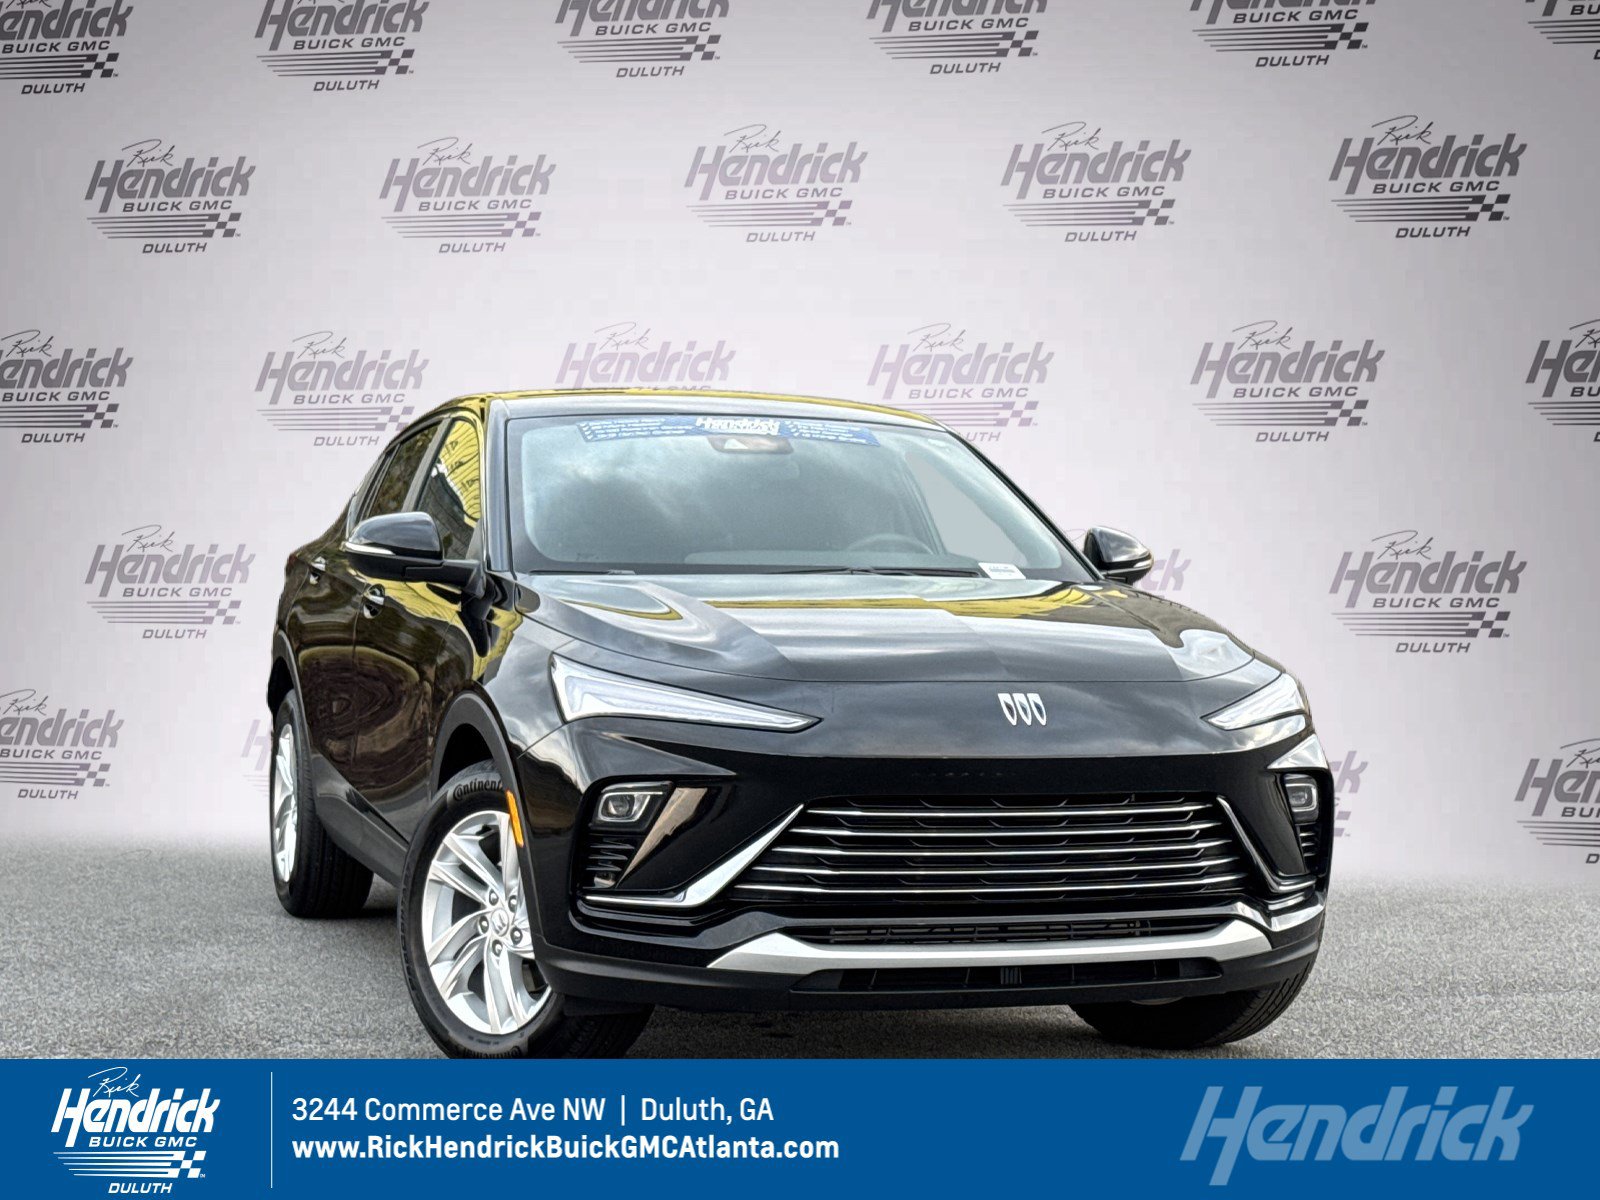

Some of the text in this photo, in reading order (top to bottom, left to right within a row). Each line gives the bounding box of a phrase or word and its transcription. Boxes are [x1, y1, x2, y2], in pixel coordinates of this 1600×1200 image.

[0, 0, 133, 40] endrick
[1233, 11, 1301, 23] BUICK
[1309, 9, 1358, 20] GMC
[255, 0, 429, 51] Hendrick
[595, 22, 711, 35] BUICK GMC
[909, 18, 1028, 31] BUICK GMC
[2, 41, 110, 54] BUICK GMC
[293, 37, 405, 50] BUICK GMC
[1256, 55, 1329, 67] DULUTH
[616, 66, 684, 77] DULUTH
[930, 63, 1001, 74] DULUTH
[21, 83, 85, 94] DULUTH
[314, 80, 379, 91] DULUTH
[1001, 139, 1191, 199] Hendrick
[1328, 133, 1527, 195] Hendrick
[684, 141, 868, 200] Hendrick
[84, 156, 256, 213] Hendrick
[379, 153, 556, 212] Hendrick
[1373, 181, 1499, 194] BUICK GMC
[725, 188, 842, 199] BUICK GMC
[1043, 186, 1165, 198] BUICK GMC
[123, 200, 232, 212] BUICK GMC
[419, 199, 531, 211] BUICK GMC
[746, 232, 815, 242] DULUTH
[1065, 231, 1137, 242] DULUTH
[1396, 226, 1471, 238] DULUTH
[142, 243, 207, 253] DULUTH
[439, 242, 505, 253] DULUTH
[0, 347, 133, 389] endrick
[555, 340, 737, 389] Hendrick
[1190, 339, 1385, 398] Hendrick
[254, 349, 430, 405] Hendrick
[867, 342, 1055, 400] Hendrick
[2, 391, 110, 402] BUICK GMC
[909, 388, 1028, 399] BUICK GMC
[1234, 386, 1358, 398] BUICK GMC
[293, 394, 405, 404] BUICK GMC
[21, 433, 85, 443] DULUTH
[314, 436, 379, 446] DULUTH
[1256, 431, 1329, 442] DULUTH
[84, 543, 256, 597] Hendrick
[1328, 550, 1527, 608] Hendrick
[123, 588, 232, 597] BUICK GMC
[1373, 598, 1499, 608] BUICK GMC
[142, 629, 207, 639] DULUTH
[1396, 643, 1471, 653] DULUTH
[0, 708, 124, 748] endrick
[0, 749, 102, 760] BUICK GMC
[18, 789, 78, 799] DULUTH
[452, 777, 503, 801] Continent
